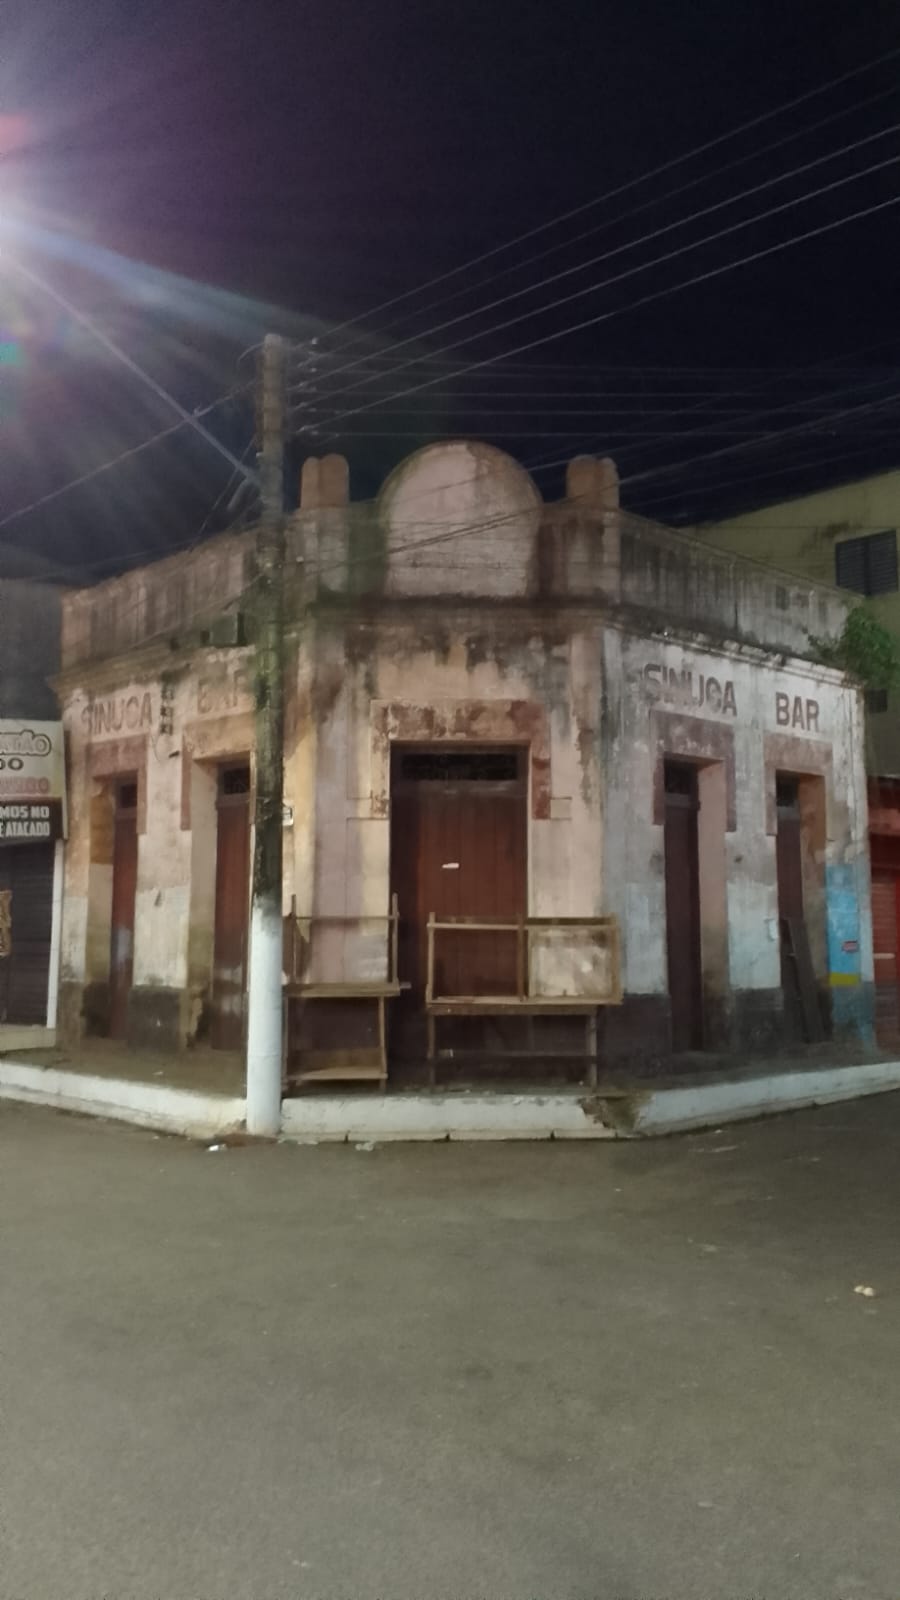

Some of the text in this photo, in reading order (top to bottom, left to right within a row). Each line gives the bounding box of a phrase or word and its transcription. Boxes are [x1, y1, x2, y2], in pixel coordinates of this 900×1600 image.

[643, 663, 820, 732] SINUCA BAR
[81, 691, 153, 735] SINUCA
[31, 806, 50, 818] NO
[6, 821, 50, 836] ATACADO
